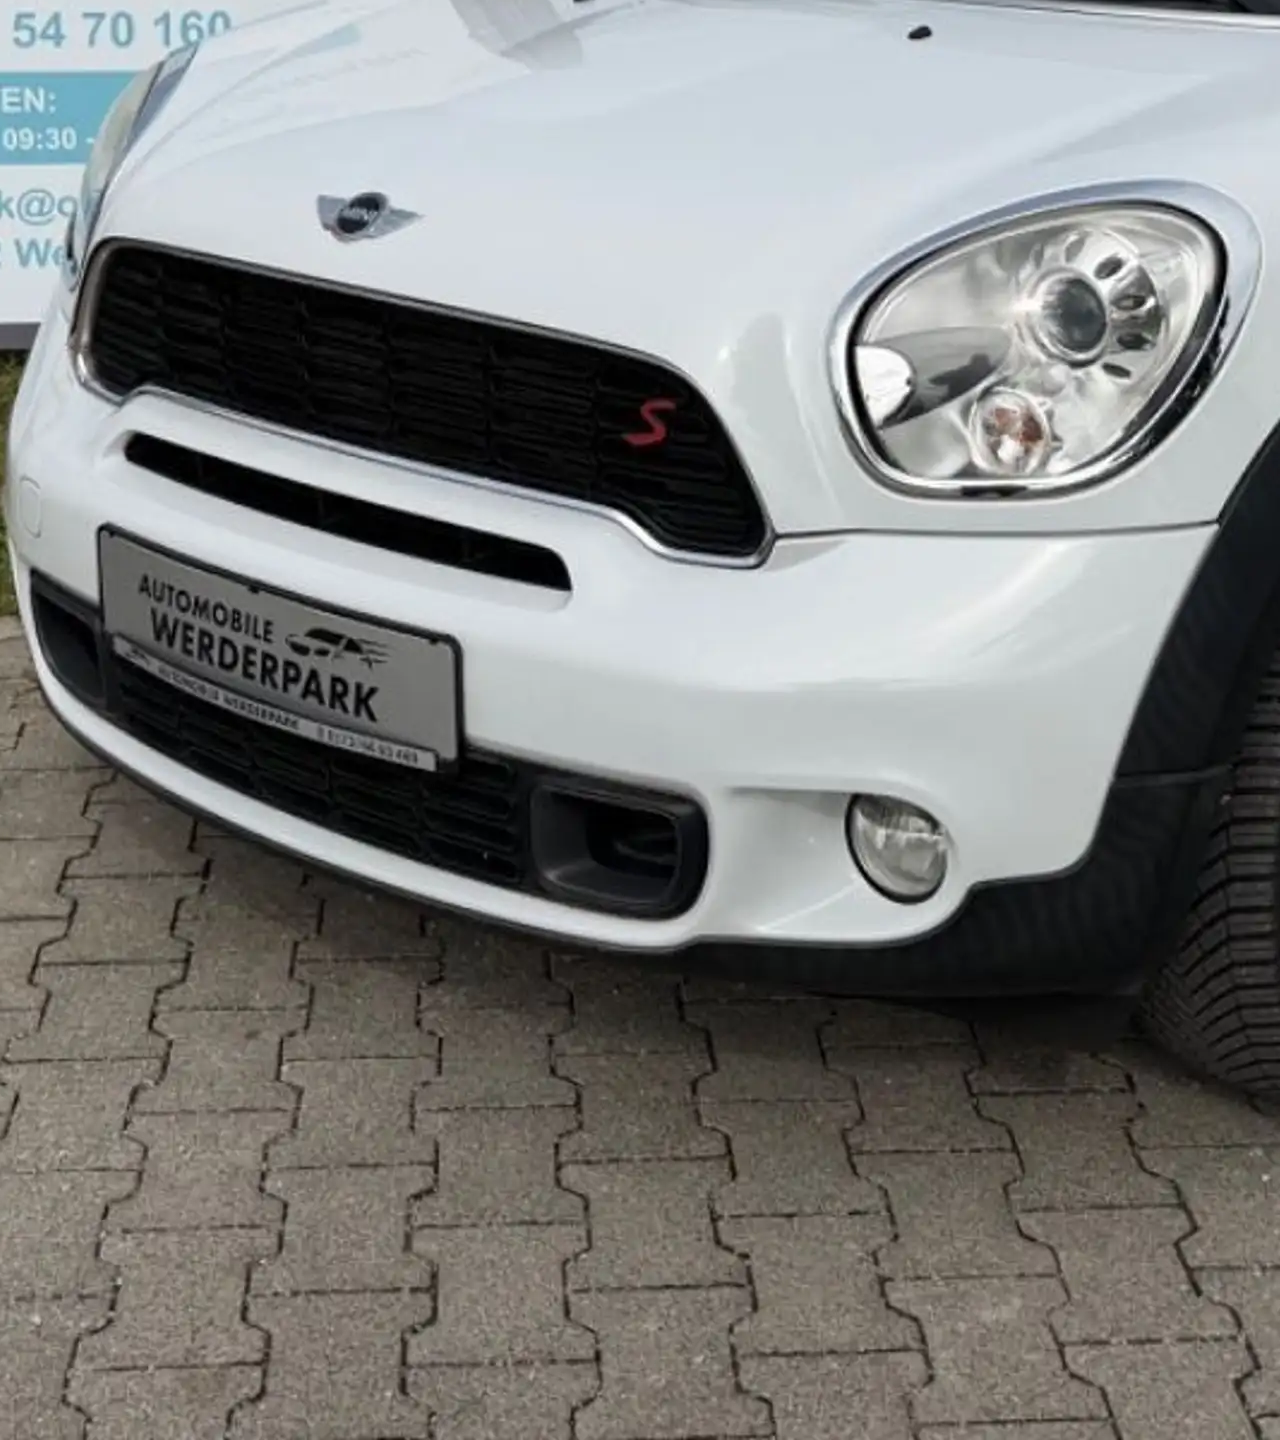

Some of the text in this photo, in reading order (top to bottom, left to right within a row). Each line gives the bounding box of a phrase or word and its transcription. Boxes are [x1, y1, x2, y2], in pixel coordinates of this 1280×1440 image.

[12, 11, 66, 49] 54
[81, 10, 134, 49] 70
[153, 9, 232, 49] 160
[2, 127, 77, 151] 09:30
[14, 237, 64, 269] We
[621, 399, 677, 447] S
[138, 574, 274, 645] AUTOMOBILE
[150, 607, 380, 724] WERDERPARK
